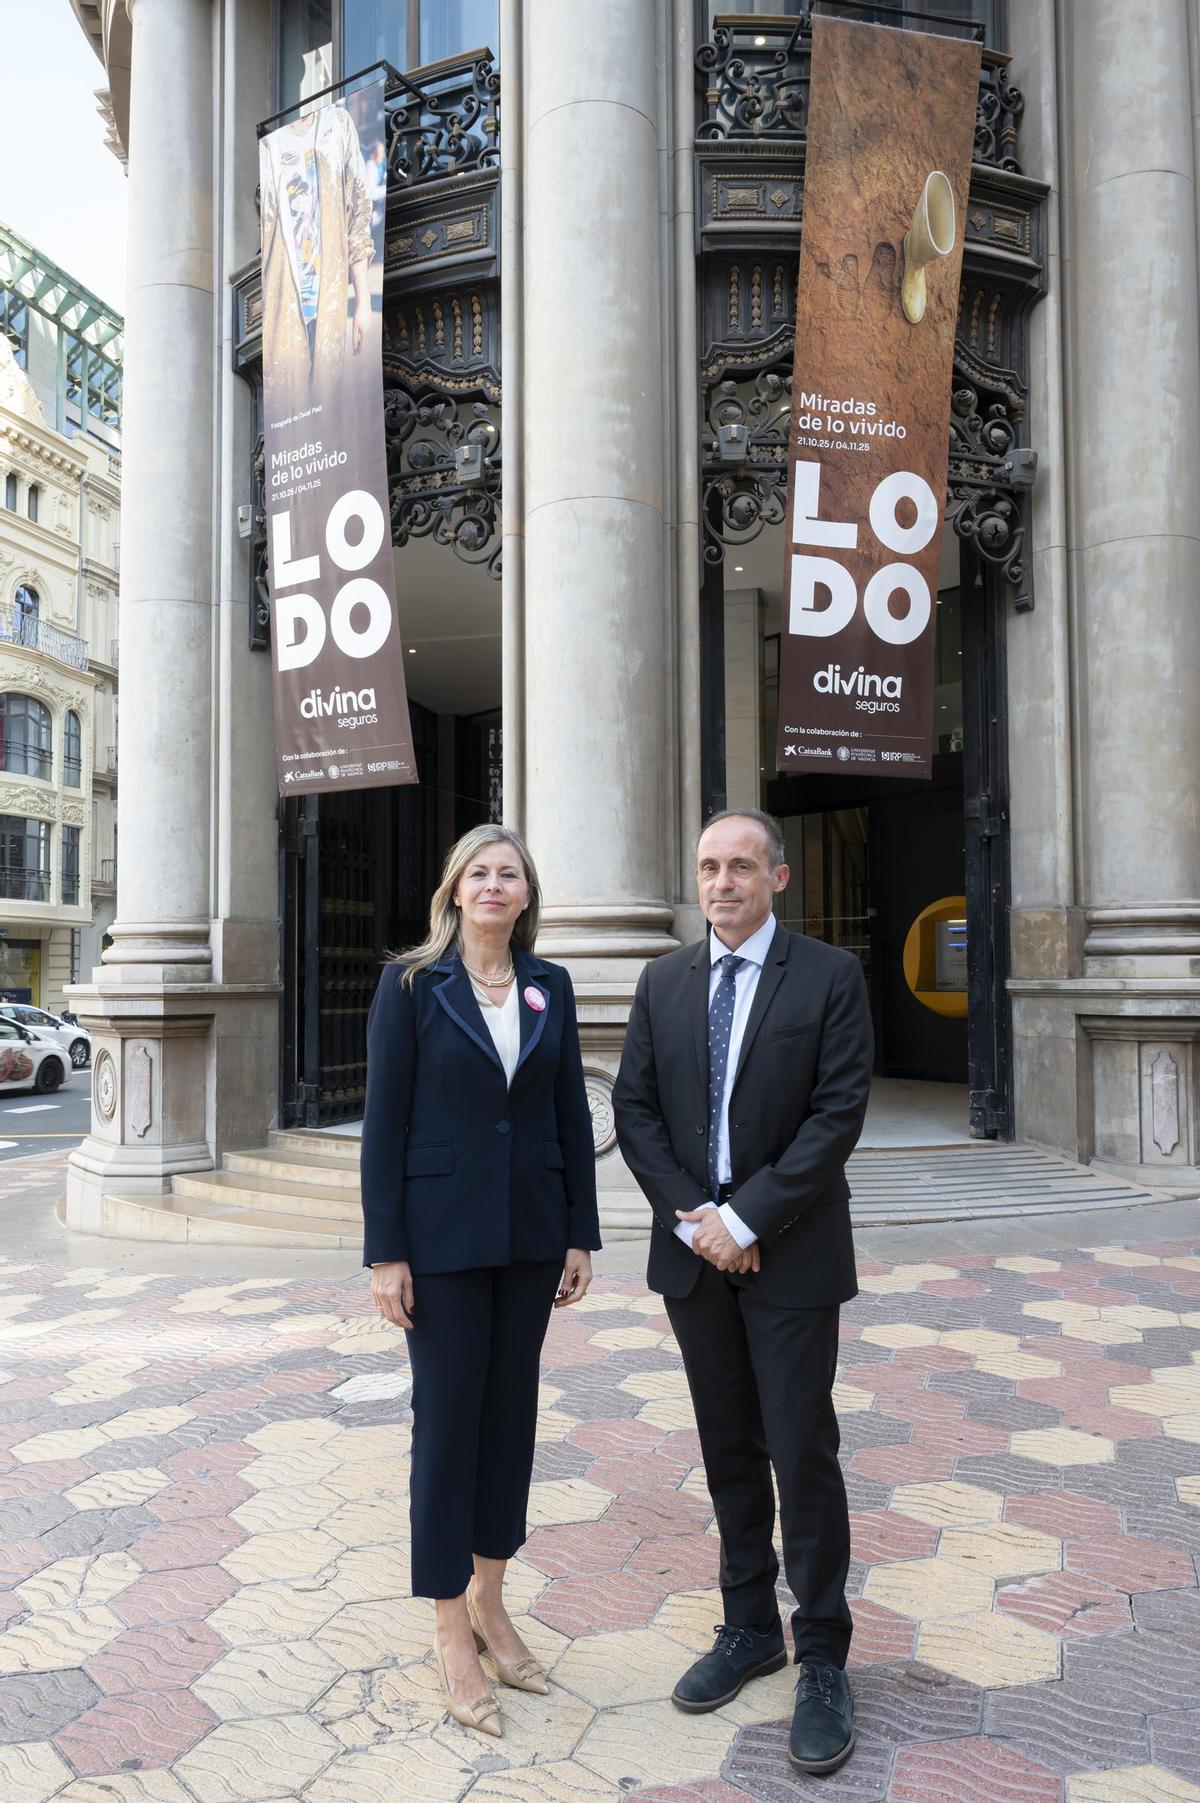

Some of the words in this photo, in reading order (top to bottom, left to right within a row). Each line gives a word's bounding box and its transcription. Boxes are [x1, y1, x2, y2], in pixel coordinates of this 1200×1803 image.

[800, 392, 877, 416] Miradas
[799, 413, 822, 431] de
[827, 415, 845, 434] lo
[850, 418, 906, 439] vivido
[271, 441, 322, 469] Miradas
[797, 436, 830, 448] 21.10.25
[836, 441, 870, 451] 04.11.25
[271, 470, 288, 487] de
[290, 465, 303, 481] lo
[305, 450, 347, 475] vivido
[271, 487, 295, 501] 21.10.25
[298, 479, 321, 493] 04.11.25
[793, 460, 938, 555] LO
[272, 490, 385, 590] LO
[788, 554, 931, 645] DO
[275, 577, 392, 672] DO
[813, 664, 902, 699] divina
[300, 685, 377, 719] divina
[855, 700, 900, 714] seguros
[337, 714, 378, 730] seguros
[784, 725, 799, 733] Con
[799, 726, 806, 734] la
[806, 728, 849, 737] colaboración
[282, 754, 293, 762] Con
[300, 748, 337, 759] colaboración
[798, 746, 832, 756] CaixaBank
[295, 769, 324, 779] CaixaBank
